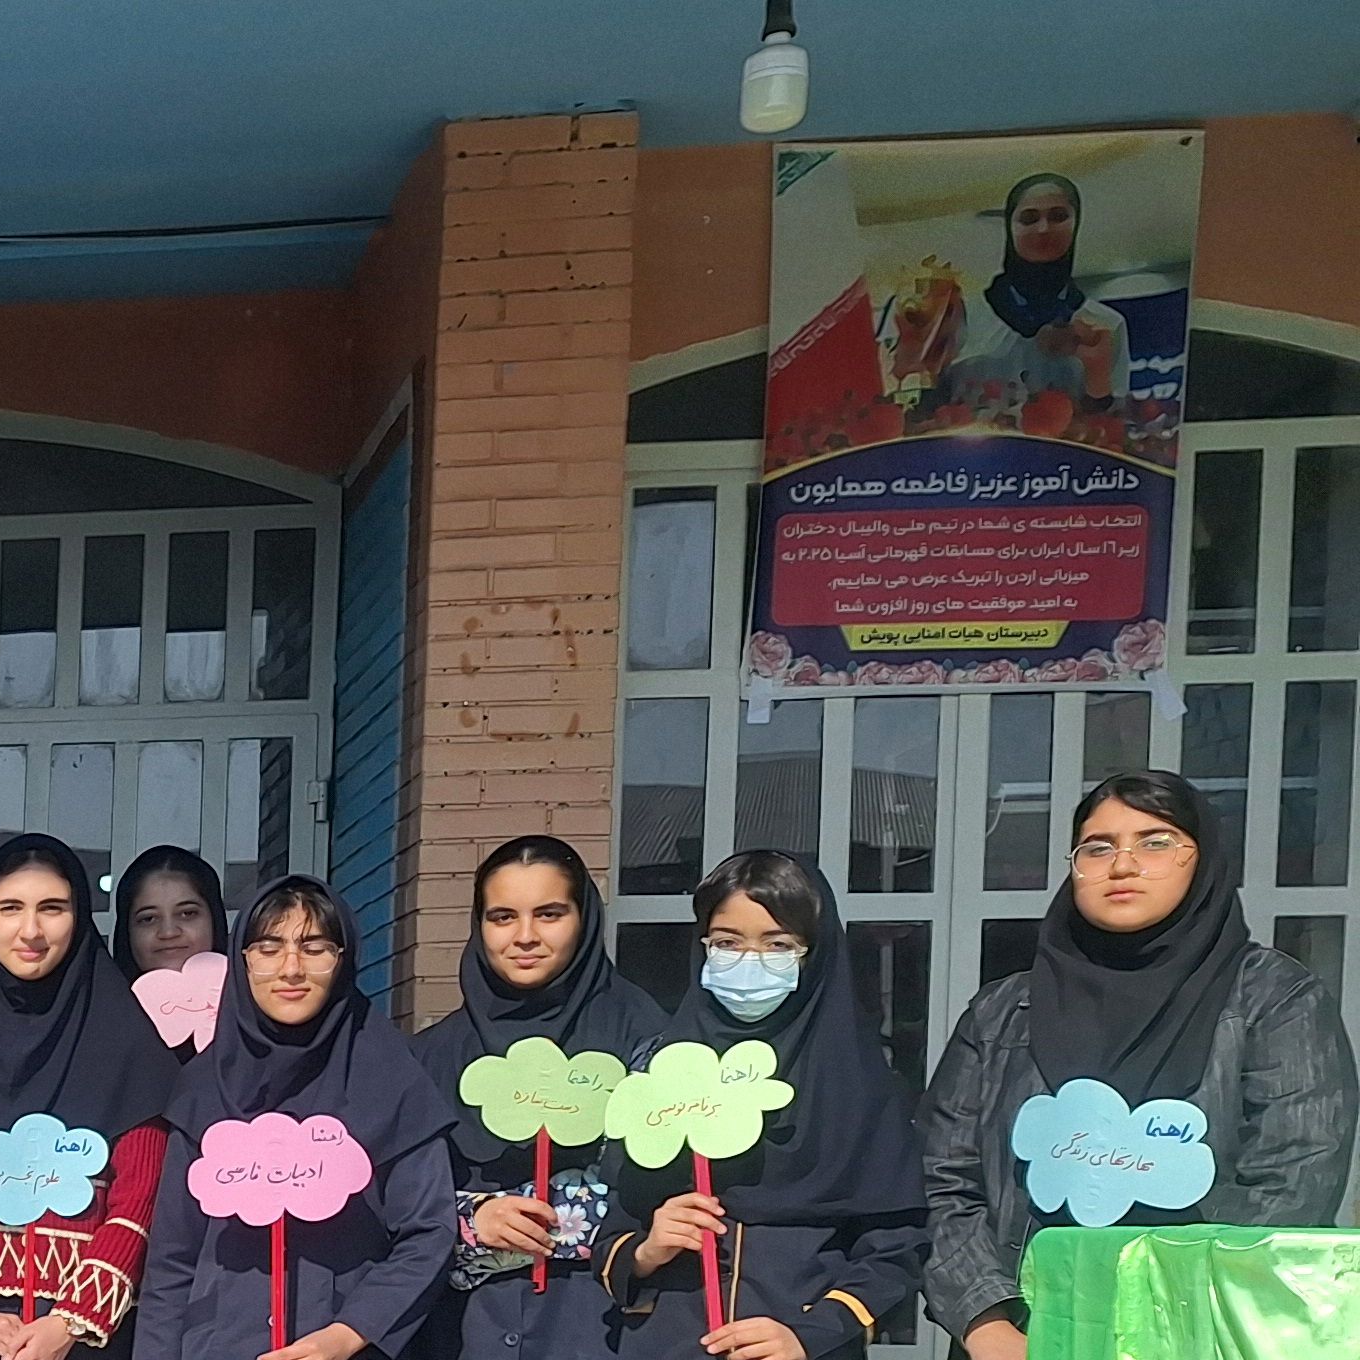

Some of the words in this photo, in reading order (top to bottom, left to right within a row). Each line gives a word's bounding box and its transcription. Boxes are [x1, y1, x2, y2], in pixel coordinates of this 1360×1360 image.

[789, 475, 887, 504] همایون
[891, 467, 969, 495] فاطمه
[970, 472, 1019, 500] عزیز
[1019, 465, 1071, 499] آموز
[1073, 466, 1140, 496] دانش
[839, 520, 890, 537] والیبال
[893, 519, 925, 536] ملی
[928, 519, 958, 535] تیم
[961, 521, 975, 535] در
[978, 516, 1010, 530] شما
[1030, 513, 1087, 532] شایسته
[1090, 514, 1142, 527] انتخاب
[783, 521, 835, 540] دختران
[834, 544, 866, 564] آسیا
[867, 543, 928, 563] قهرمانی
[930, 544, 995, 560] مسابقات
[997, 543, 1027, 560] برای
[1030, 542, 1065, 559] ایران
[1066, 541, 1100, 556] سال
[1117, 544, 1140, 558] زیر
[781, 551, 796, 565] به
[884, 575, 908, 589] می
[911, 572, 948, 588] عرض
[951, 569, 992, 587] تبریک
[994, 570, 1003, 587] را
[1006, 570, 1036, 587] اردن
[1039, 568, 1090, 587] میزبانی
[835, 598, 864, 614] شما
[867, 596, 908, 616] افزون
[909, 599, 930, 615] روز
[932, 596, 965, 614] های
[967, 596, 1027, 613] موفقیت
[1030, 595, 1061, 613] امید
[1063, 598, 1078, 611] به
[860, 628, 901, 646] پویش
[902, 627, 945, 643] امنایی
[949, 626, 984, 642] هیات
[986, 626, 1049, 643] دبیرستان
[1050, 1131, 1092, 1161] زندگی
[215, 1160, 262, 1184] فارسی
[266, 1158, 324, 1188] ادبیات
[33, 1168, 61, 1195] علوم
